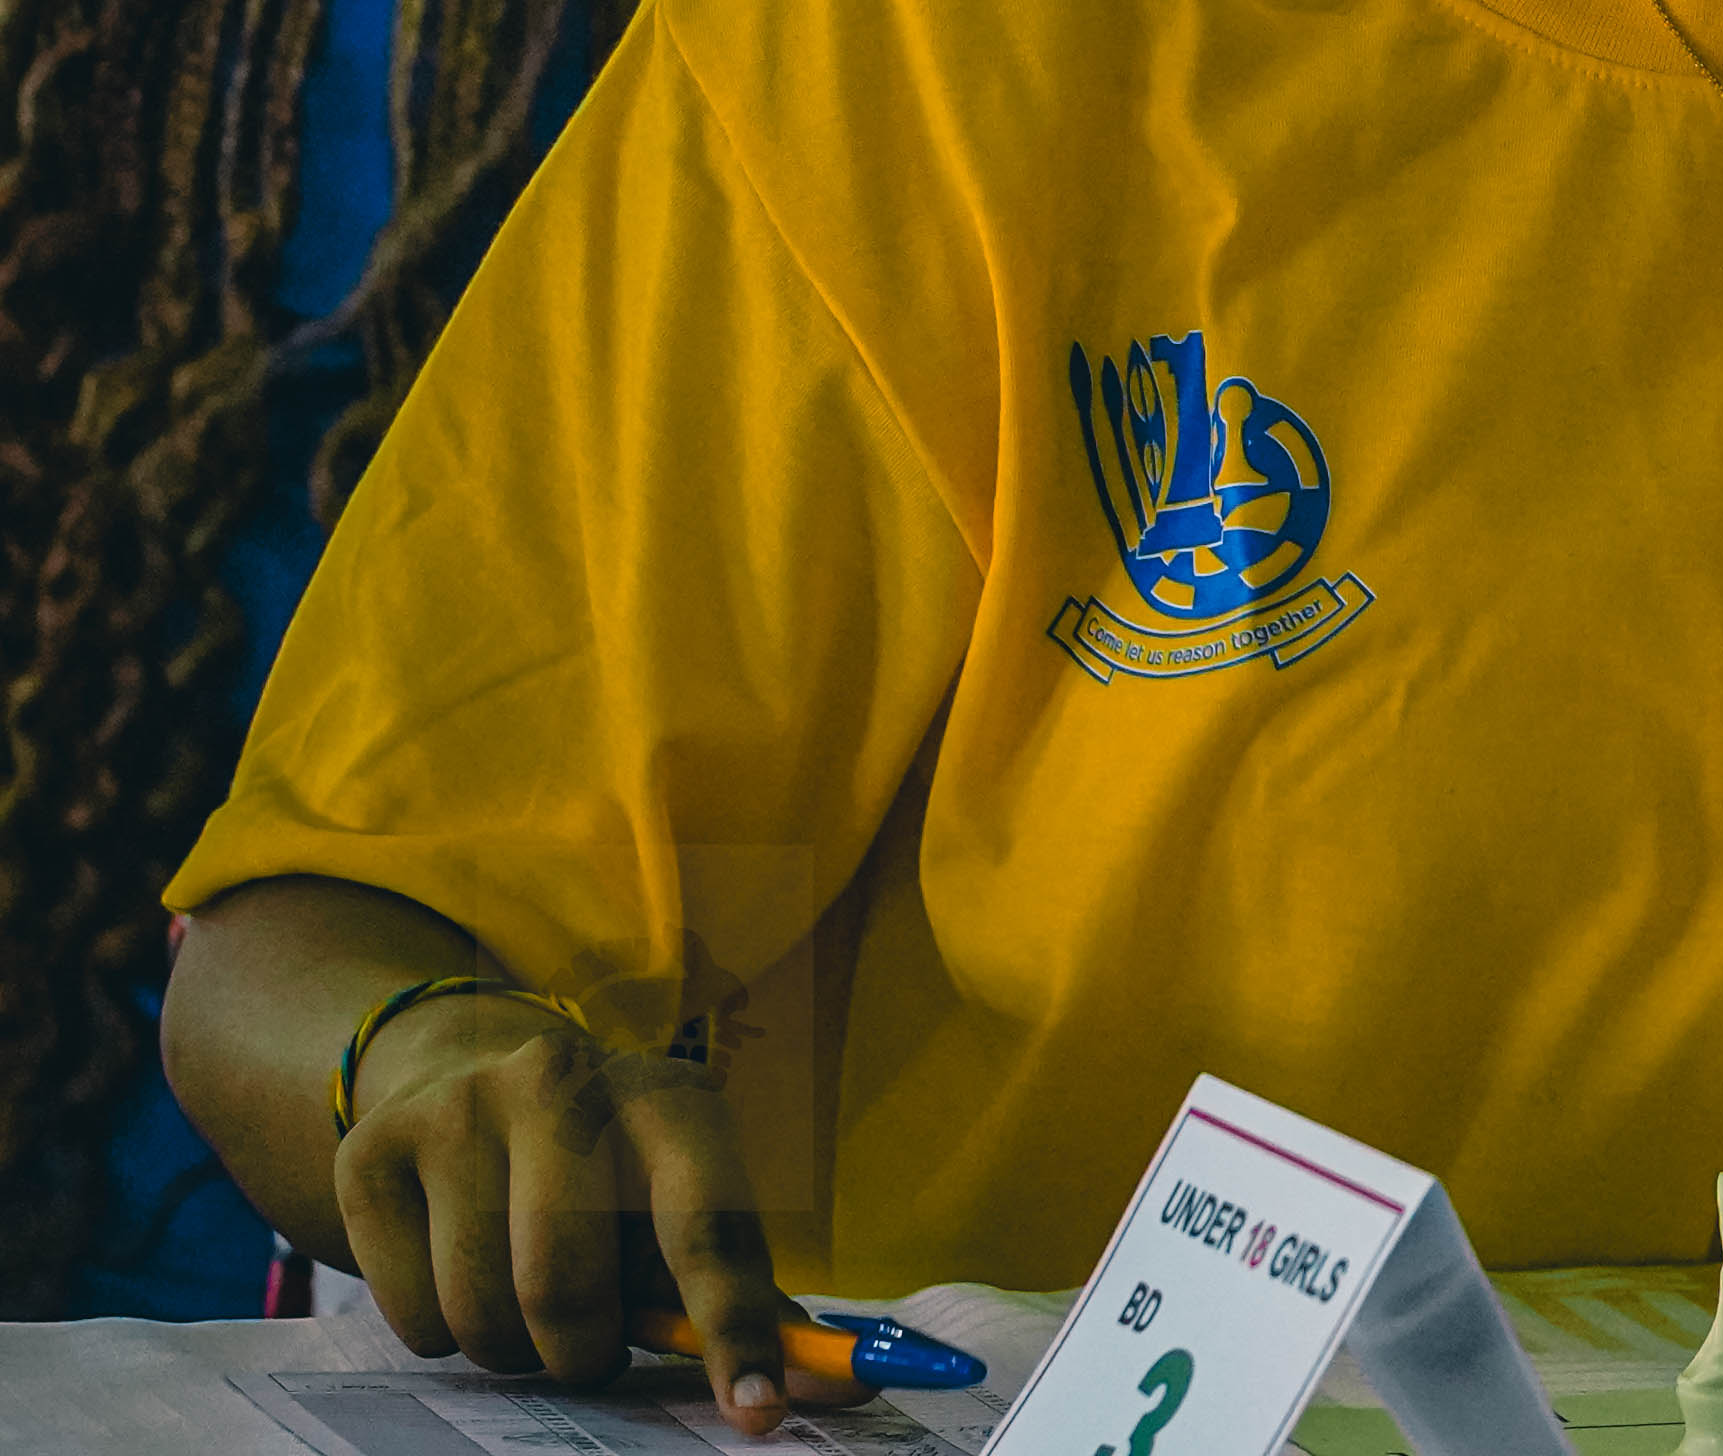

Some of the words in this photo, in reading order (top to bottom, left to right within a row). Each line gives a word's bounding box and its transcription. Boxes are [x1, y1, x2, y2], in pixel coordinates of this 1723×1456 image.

[1086, 617, 1124, 654] Come
[1125, 640, 1144, 662] let
[1146, 649, 1164, 665] us
[1166, 639, 1226, 665] reason
[1231, 599, 1322, 648] together
[1160, 1179, 1248, 1255] UNDER
[1240, 1219, 1278, 1269] 18
[1269, 1232, 1350, 1305] GIRLS
[1117, 1281, 1162, 1334] BD
[1093, 1346, 1195, 1456] 3
